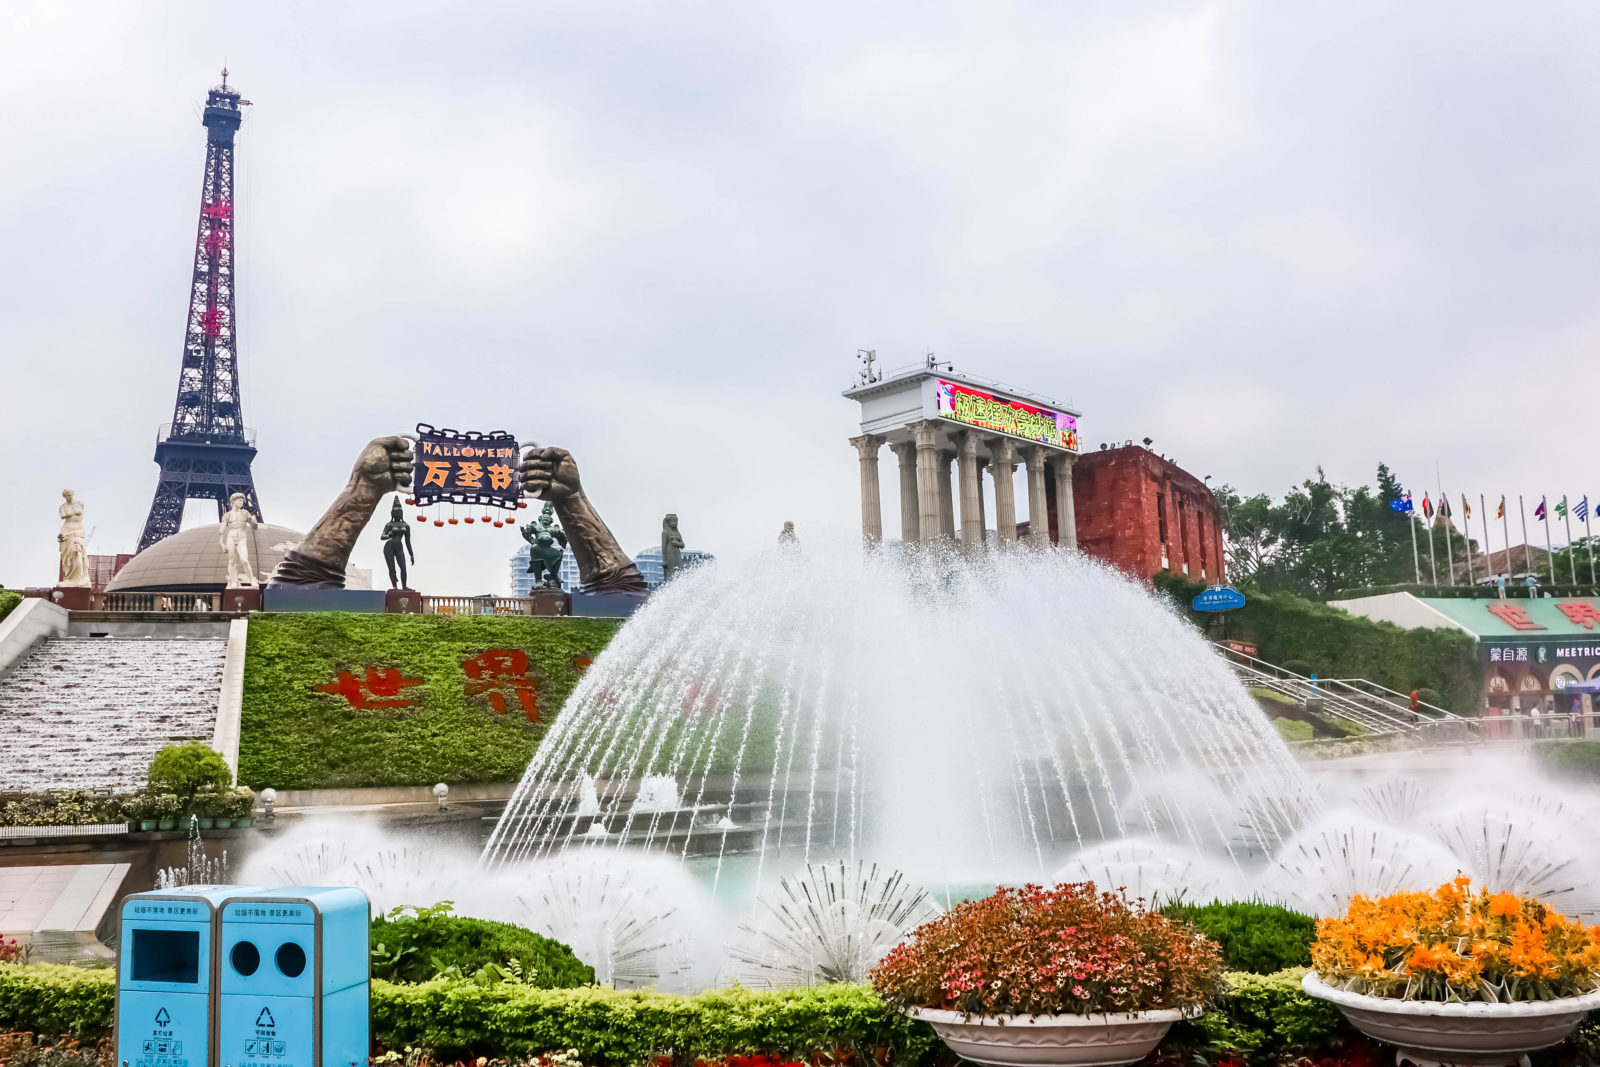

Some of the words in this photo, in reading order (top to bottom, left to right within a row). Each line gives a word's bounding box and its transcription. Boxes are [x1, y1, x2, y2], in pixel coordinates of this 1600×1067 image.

[422, 461, 515, 491] 万圣节
[1485, 603, 1600, 630] 世界
[1490, 647, 1528, 662] 蒙自源
[1556, 646, 1600, 658] MEETRIC
